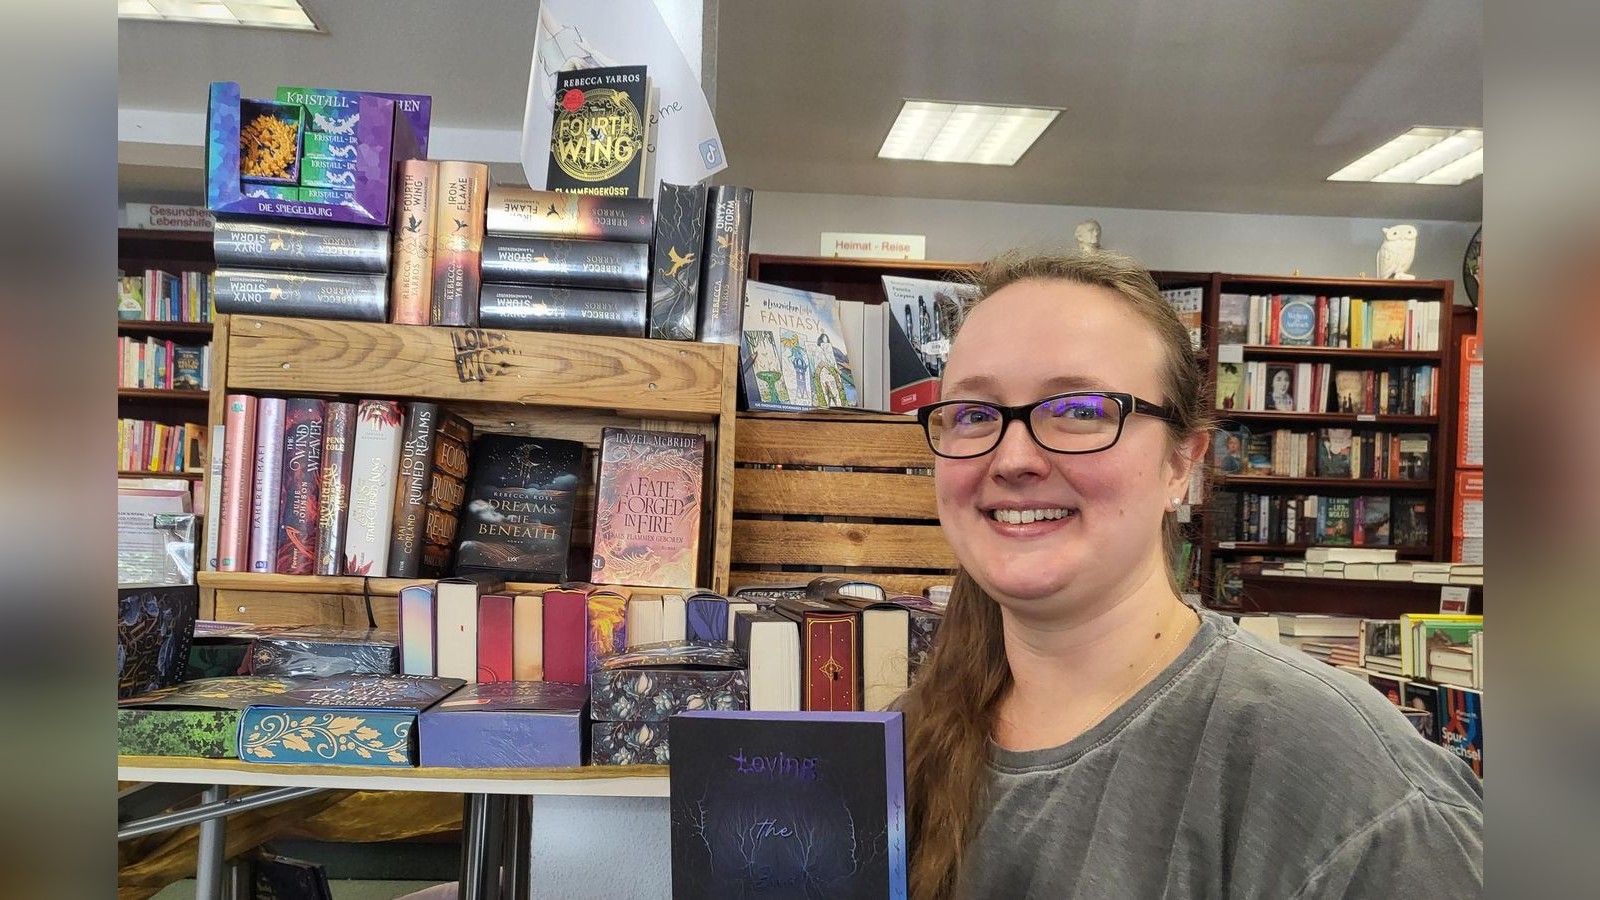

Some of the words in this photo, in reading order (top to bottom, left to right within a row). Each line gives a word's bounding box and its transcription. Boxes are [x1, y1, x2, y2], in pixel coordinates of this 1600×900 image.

[563, 76, 603, 88] REBECCA
[605, 74, 640, 84] YARROS
[559, 113, 634, 137] FOURTH
[558, 136, 634, 163] WING
[403, 174, 414, 212] FOURTH
[413, 180, 423, 206] WING
[448, 181, 457, 206] IRON
[457, 177, 468, 211] FLAME
[258, 202, 273, 213] DIE
[274, 203, 333, 217] SPIEGELBURG
[504, 203, 538, 214] FLAME
[591, 208, 625, 217] YARROS
[715, 202, 726, 229] ONYX
[724, 200, 736, 233] STORM
[149, 216, 212, 228] Lebenshilfe
[594, 217, 629, 227] REBECC
[230, 232, 267, 243] STORM
[835, 239, 872, 251] Heimat
[881, 241, 911, 252] Reise
[234, 243, 263, 254] ONYX
[498, 252, 533, 262] STORM
[582, 263, 623, 274] REBECCA
[230, 282, 267, 292] STORM
[403, 260, 412, 300] REBECCA
[411, 263, 420, 297] YARROS
[233, 292, 262, 303] ONYX
[317, 294, 359, 304] REBECCA
[320, 286, 356, 295] YARROS
[711, 278, 723, 319] REBECCA
[497, 298, 532, 308] STORM
[581, 310, 621, 320] REBECCA
[760, 310, 821, 332] FANTASY
[326, 436, 345, 444] PENN
[416, 410, 432, 457] REALMS
[616, 433, 648, 445] HAZEL
[653, 435, 697, 449] McBRIDE
[287, 435, 295, 451] THE
[289, 424, 310, 472] WIND
[307, 417, 323, 473] WEAVER
[325, 443, 345, 451] COLE
[402, 438, 417, 476] FOUR
[441, 442, 468, 478] FOUR
[409, 460, 425, 506] RUINED
[431, 475, 465, 506] RUINED
[625, 483, 636, 496] A
[637, 476, 676, 499] FATE
[293, 489, 301, 515] JULIE
[299, 481, 308, 523] JOHNSON
[319, 467, 332, 528] EVERFLAME
[493, 491, 529, 499] REBECCA
[488, 499, 557, 515] DREAMS
[616, 494, 685, 516] FORGED
[510, 515, 530, 524] LIE
[624, 514, 636, 527] IN
[636, 514, 674, 534] FIRE
[398, 525, 406, 541] MAI
[404, 514, 416, 554] CORLAND
[478, 523, 557, 540] BENEATH
[626, 533, 655, 542] FLAMMEN
[290, 548, 298, 569] Forever
[1441, 726, 1468, 743] Spur-
[755, 818, 794, 840] the
